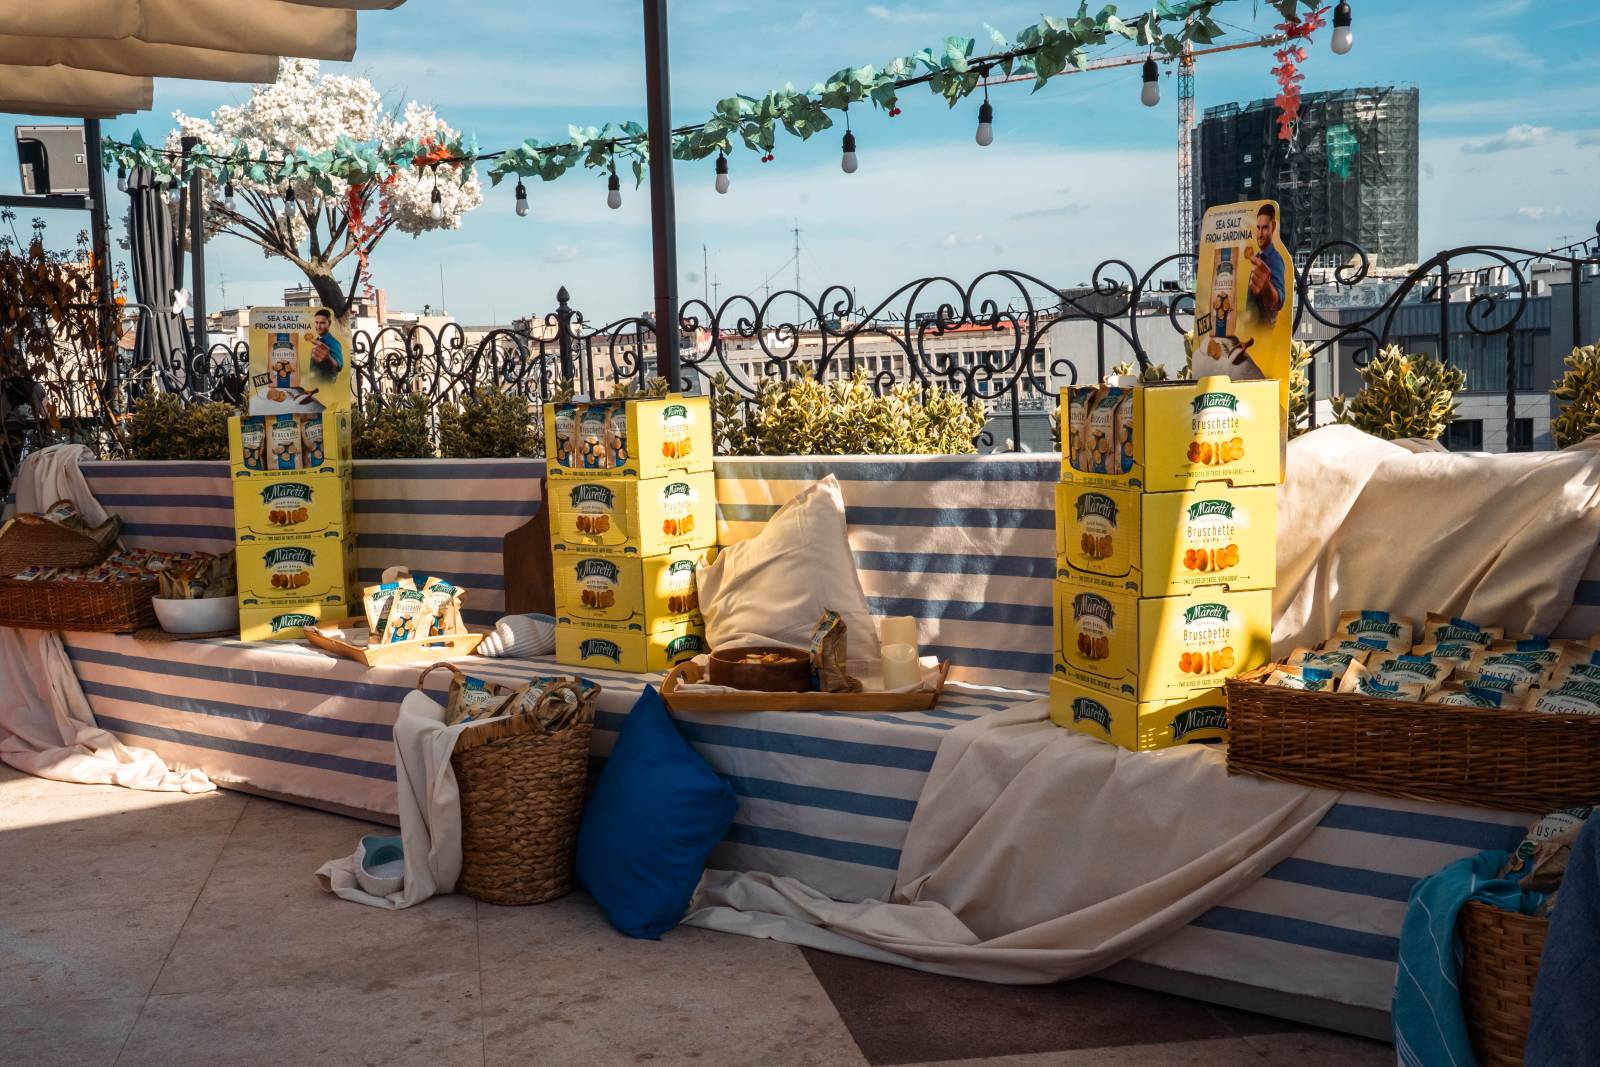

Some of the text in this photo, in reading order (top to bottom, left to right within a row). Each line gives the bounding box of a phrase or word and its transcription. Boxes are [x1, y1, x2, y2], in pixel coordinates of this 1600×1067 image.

[1215, 217, 1242, 230] SEA SALT
[1205, 229, 1253, 243] FROM SARDINIA
[255, 322, 312, 330] FROM SARDINIA
[254, 374, 270, 386] NEW
[1197, 394, 1233, 410] Maretti
[1191, 417, 1239, 431] Bruschette
[266, 484, 308, 501] Maretti
[574, 485, 609, 504] Maretti
[1080, 494, 1114, 518] Maretti
[1192, 501, 1230, 520] Maretti
[1188, 524, 1235, 538] Bruschette
[268, 549, 310, 566] Maretti
[580, 560, 614, 578] Maretti
[1076, 594, 1110, 619] Maretti
[1188, 605, 1225, 623] Maretti
[275, 615, 313, 631] Maretti
[1351, 619, 1393, 633] Maretti
[1183, 627, 1230, 641] Bruschette
[1438, 626, 1481, 641] Maretti
[584, 640, 616, 657] Maretti
[1385, 659, 1430, 676] Maretti
[1077, 699, 1107, 725] Maretti
